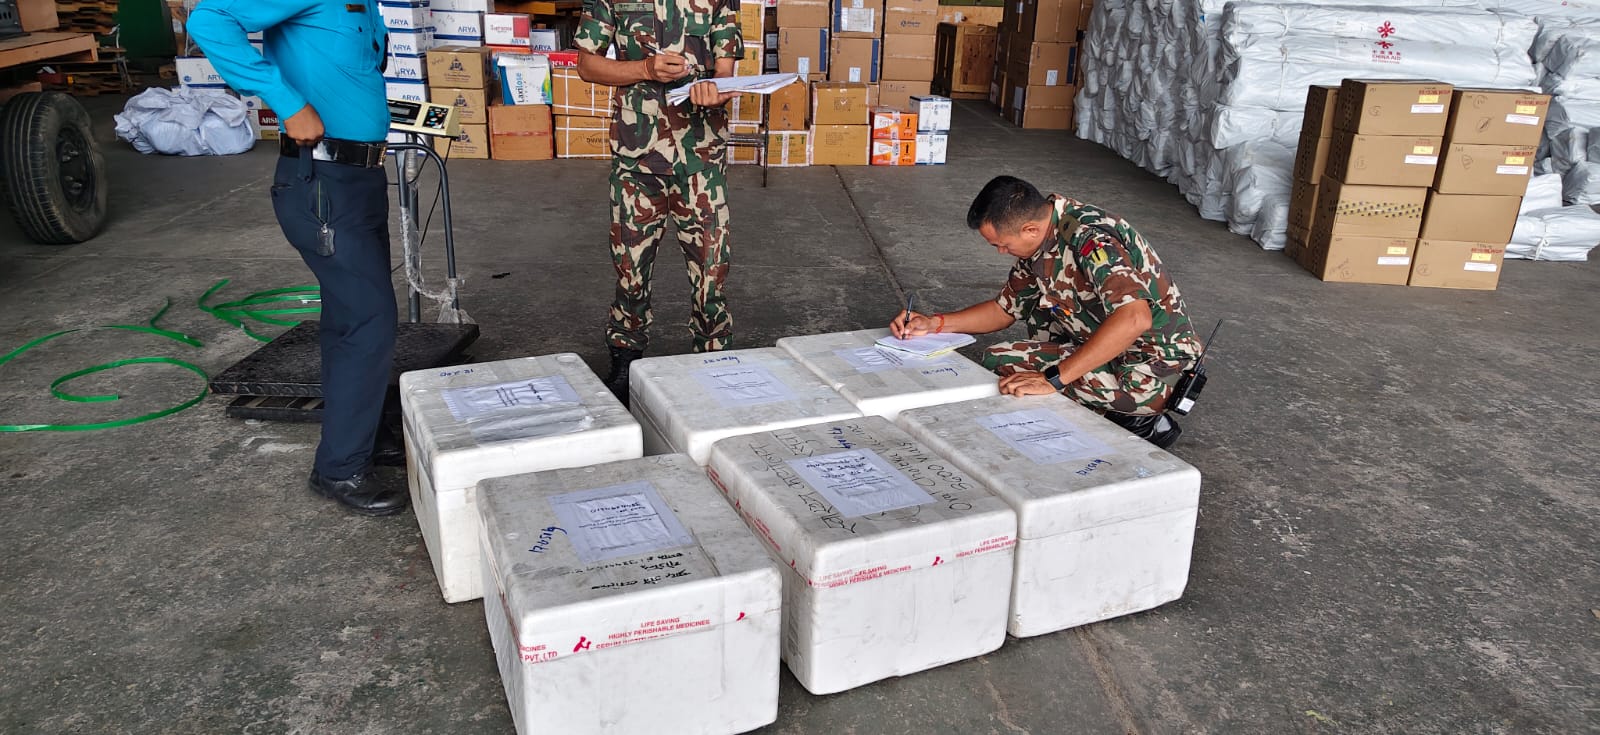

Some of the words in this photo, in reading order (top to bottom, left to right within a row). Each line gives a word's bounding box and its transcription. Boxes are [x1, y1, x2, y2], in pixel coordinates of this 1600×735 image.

[390, 18, 409, 26] ARYA
[402, 94, 421, 102] ARYA
[656, 617, 681, 626] SAVING
[608, 631, 633, 640] HIGHLY
[633, 625, 675, 637] PERISHABLE
[675, 619, 711, 630] MEDICINES
